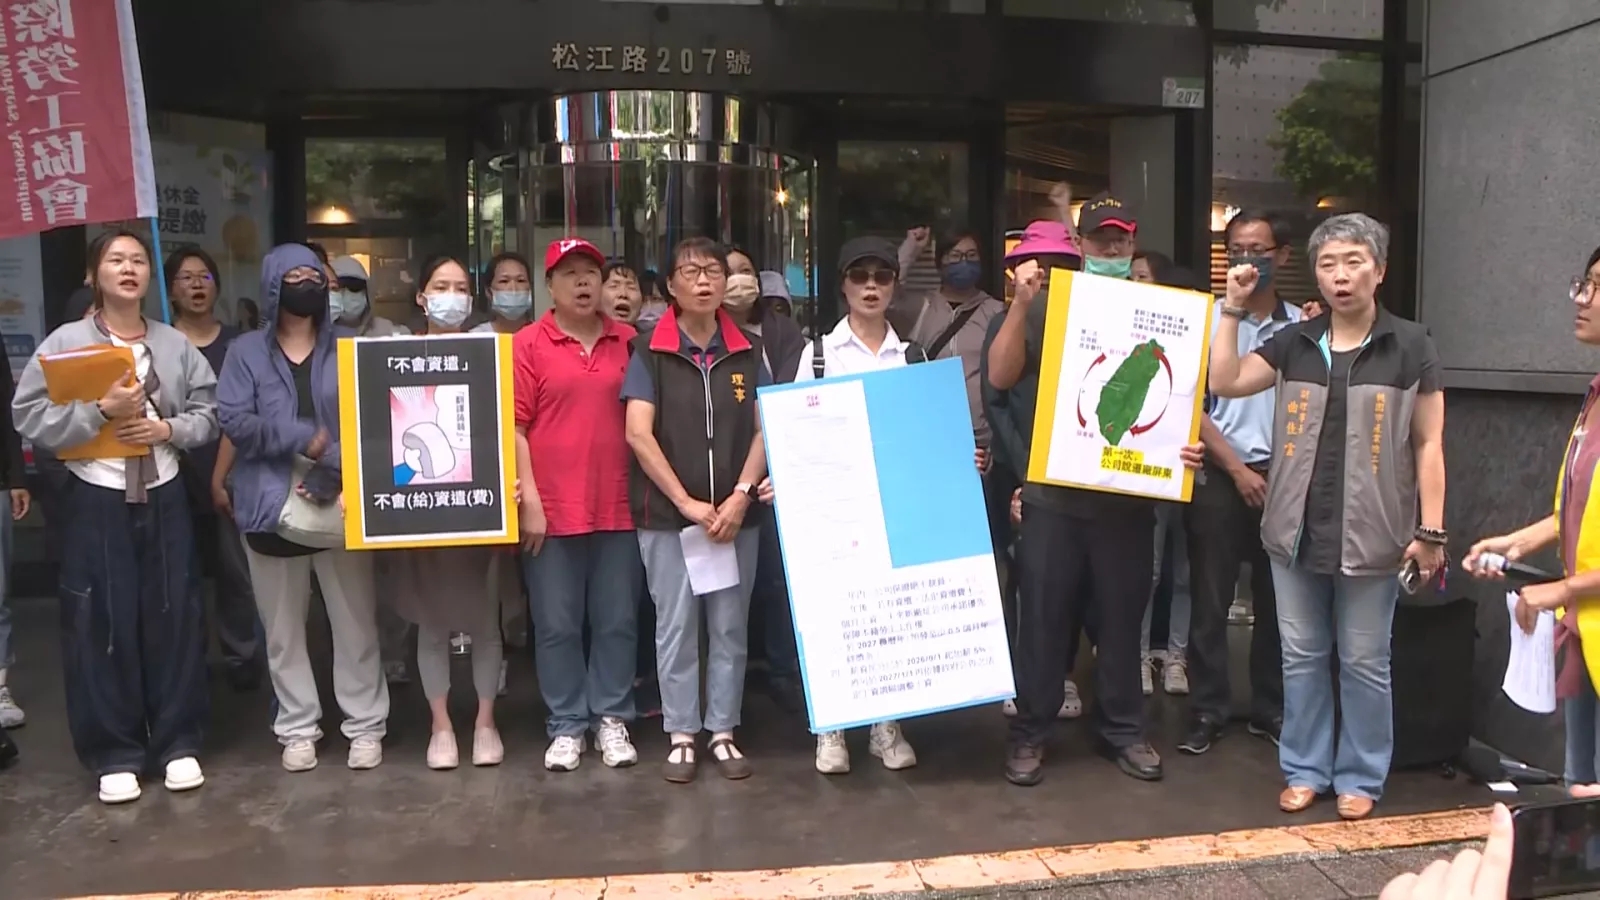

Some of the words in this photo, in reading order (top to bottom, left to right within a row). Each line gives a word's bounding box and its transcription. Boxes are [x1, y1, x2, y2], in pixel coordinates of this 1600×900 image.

[551, 43, 753, 76] 松江路207號
[1176, 90, 1201, 104] 207
[731, 373, 746, 404] 理事
[373, 489, 494, 511] 不會(給)資遣(費)
[857, 639, 878, 651] 2027
